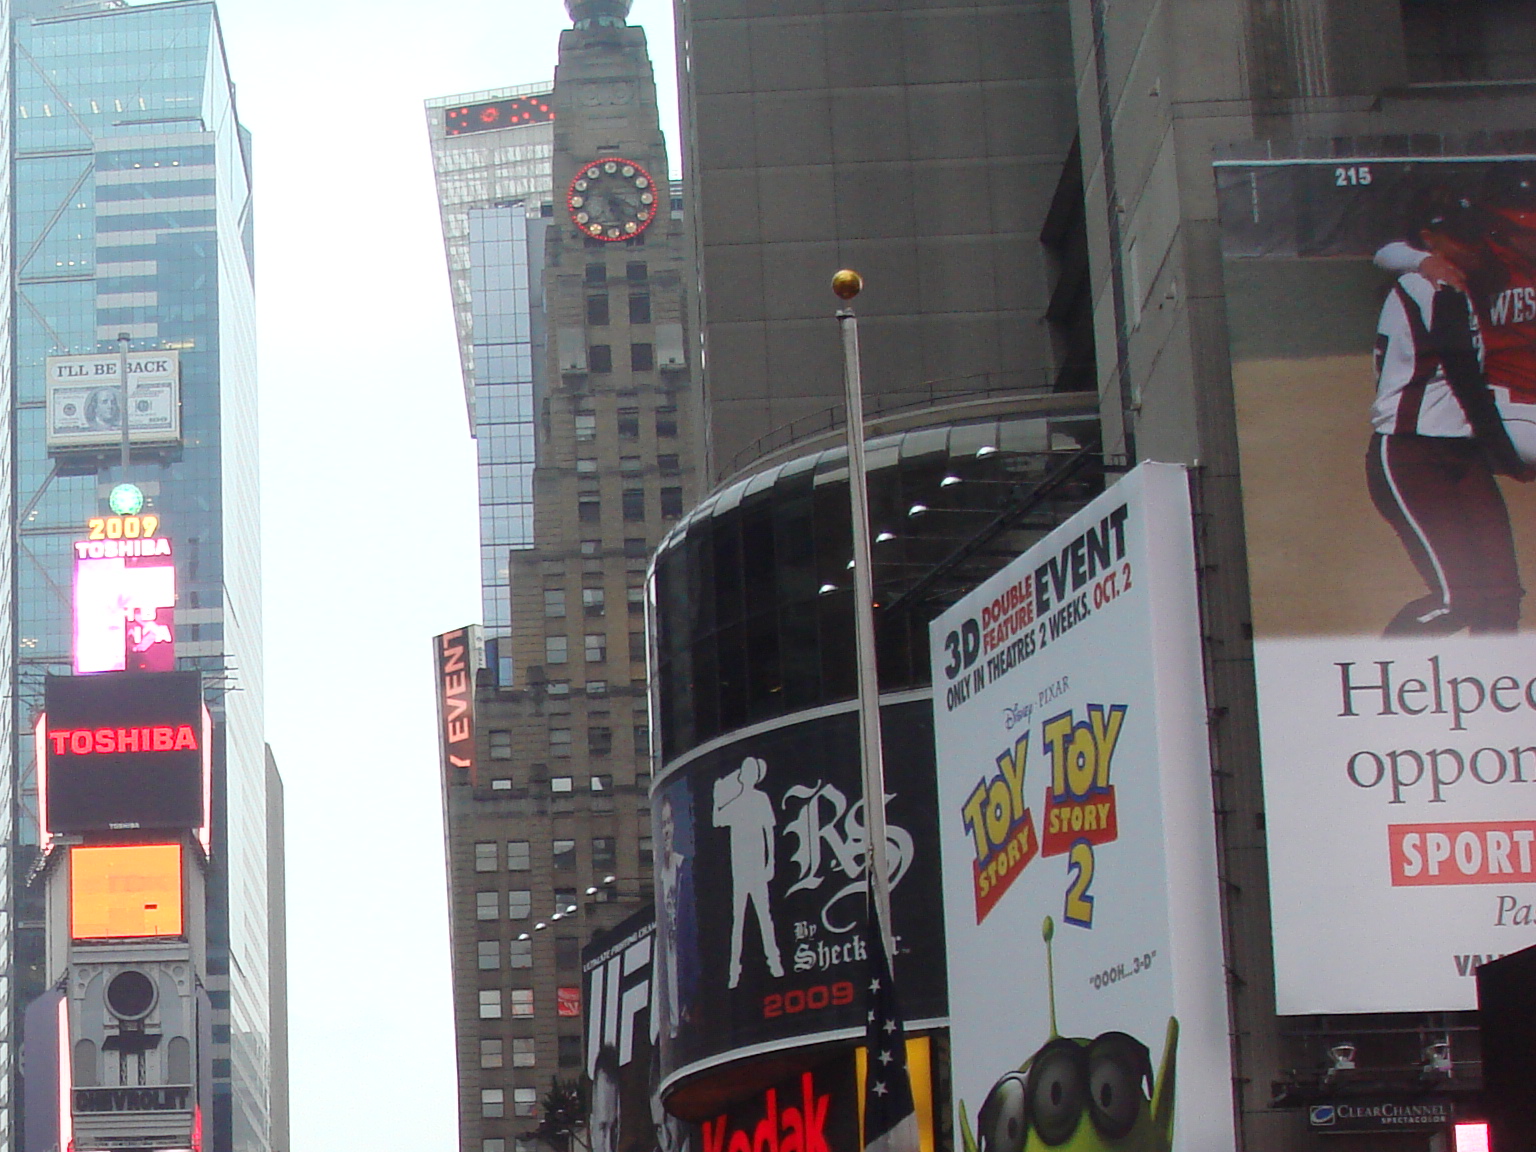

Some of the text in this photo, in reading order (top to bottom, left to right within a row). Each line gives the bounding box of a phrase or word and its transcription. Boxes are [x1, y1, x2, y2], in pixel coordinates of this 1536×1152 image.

[1335, 167, 1372, 187] 215
[58, 361, 168, 377] I'LL BE BACK
[89, 516, 158, 540] 2009
[75, 539, 172, 559] TOSHIBA
[1036, 503, 1128, 613] EVENT
[982, 574, 1032, 630] DOUBLE
[946, 562, 1132, 712] ONLY IN THEATRES 2 WEEKS. OCT. 2
[983, 601, 1034, 656] FEATURE
[944, 618, 980, 680] 3D
[1038, 675, 1070, 708] PIXAR
[50, 726, 198, 756] TOSHIBA
[1042, 704, 1128, 803] TOY
[962, 729, 1031, 872] TOY
[1049, 804, 1111, 834] STORY
[978, 825, 1031, 898] STORY
[1063, 837, 1095, 930] 2
[794, 921, 817, 941] By
[794, 935, 902, 971] Sheckr
[763, 981, 855, 1019] 2009
